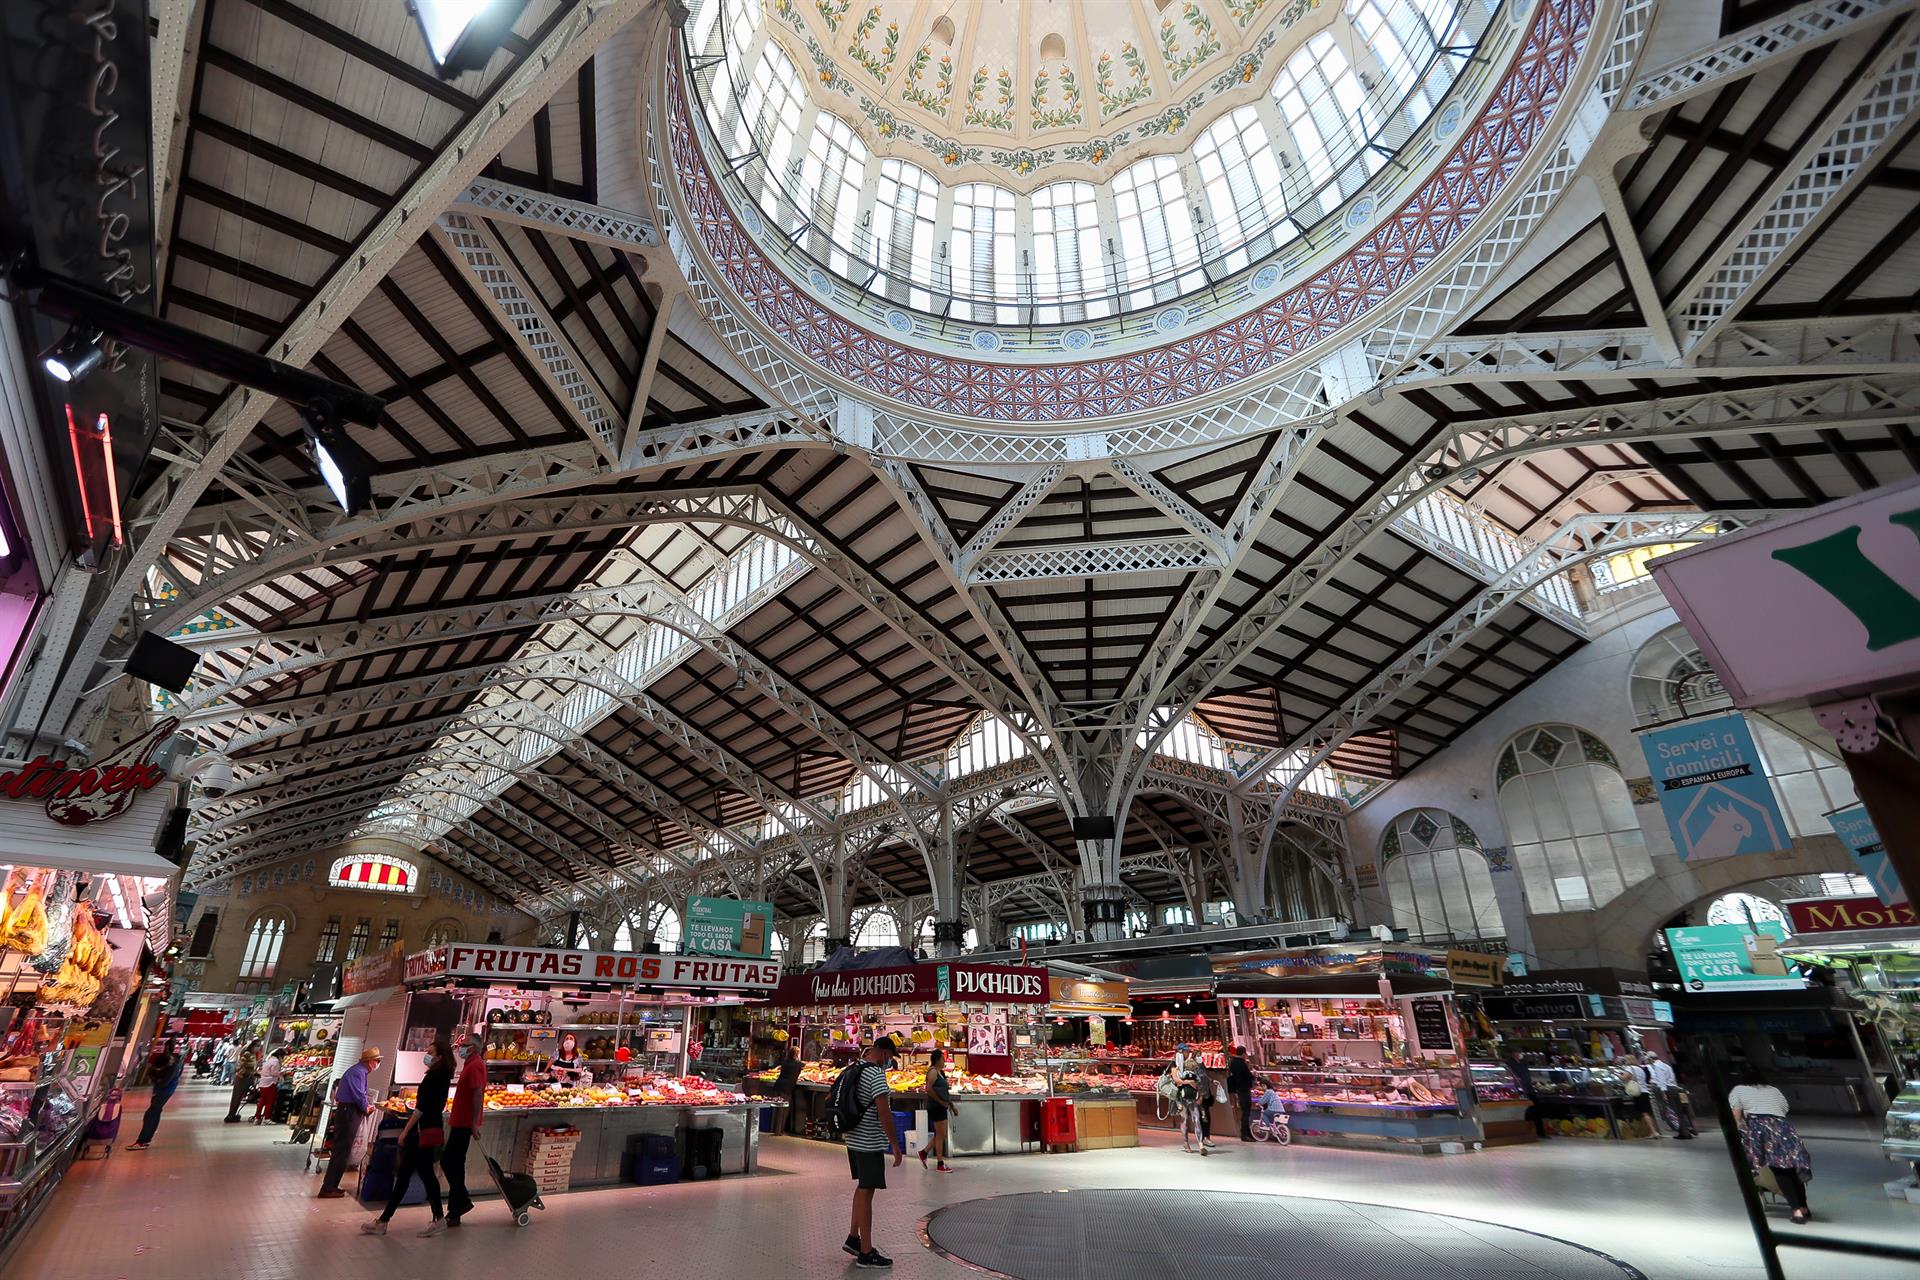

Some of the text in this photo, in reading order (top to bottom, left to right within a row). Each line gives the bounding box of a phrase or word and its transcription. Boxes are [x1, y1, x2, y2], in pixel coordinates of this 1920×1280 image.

[1657, 732, 1736, 759] Servei a
[1664, 748, 1744, 778] domicili
[1681, 772, 1711, 786] ESPANYA
[1717, 767, 1746, 779] EUROPA
[701, 925, 734, 933] LLEVAMOS
[689, 938, 732, 951] A CASA
[451, 947, 583, 976] FRUTAS
[595, 956, 661, 980] ROS
[673, 960, 779, 985] FRUTAS
[1687, 964, 1744, 977] A CASA
[853, 973, 916, 996] PUCHADES
[956, 971, 1043, 996] PUCHADES
[1537, 979, 1584, 994] andreu
[1526, 1002, 1576, 1014] natura
